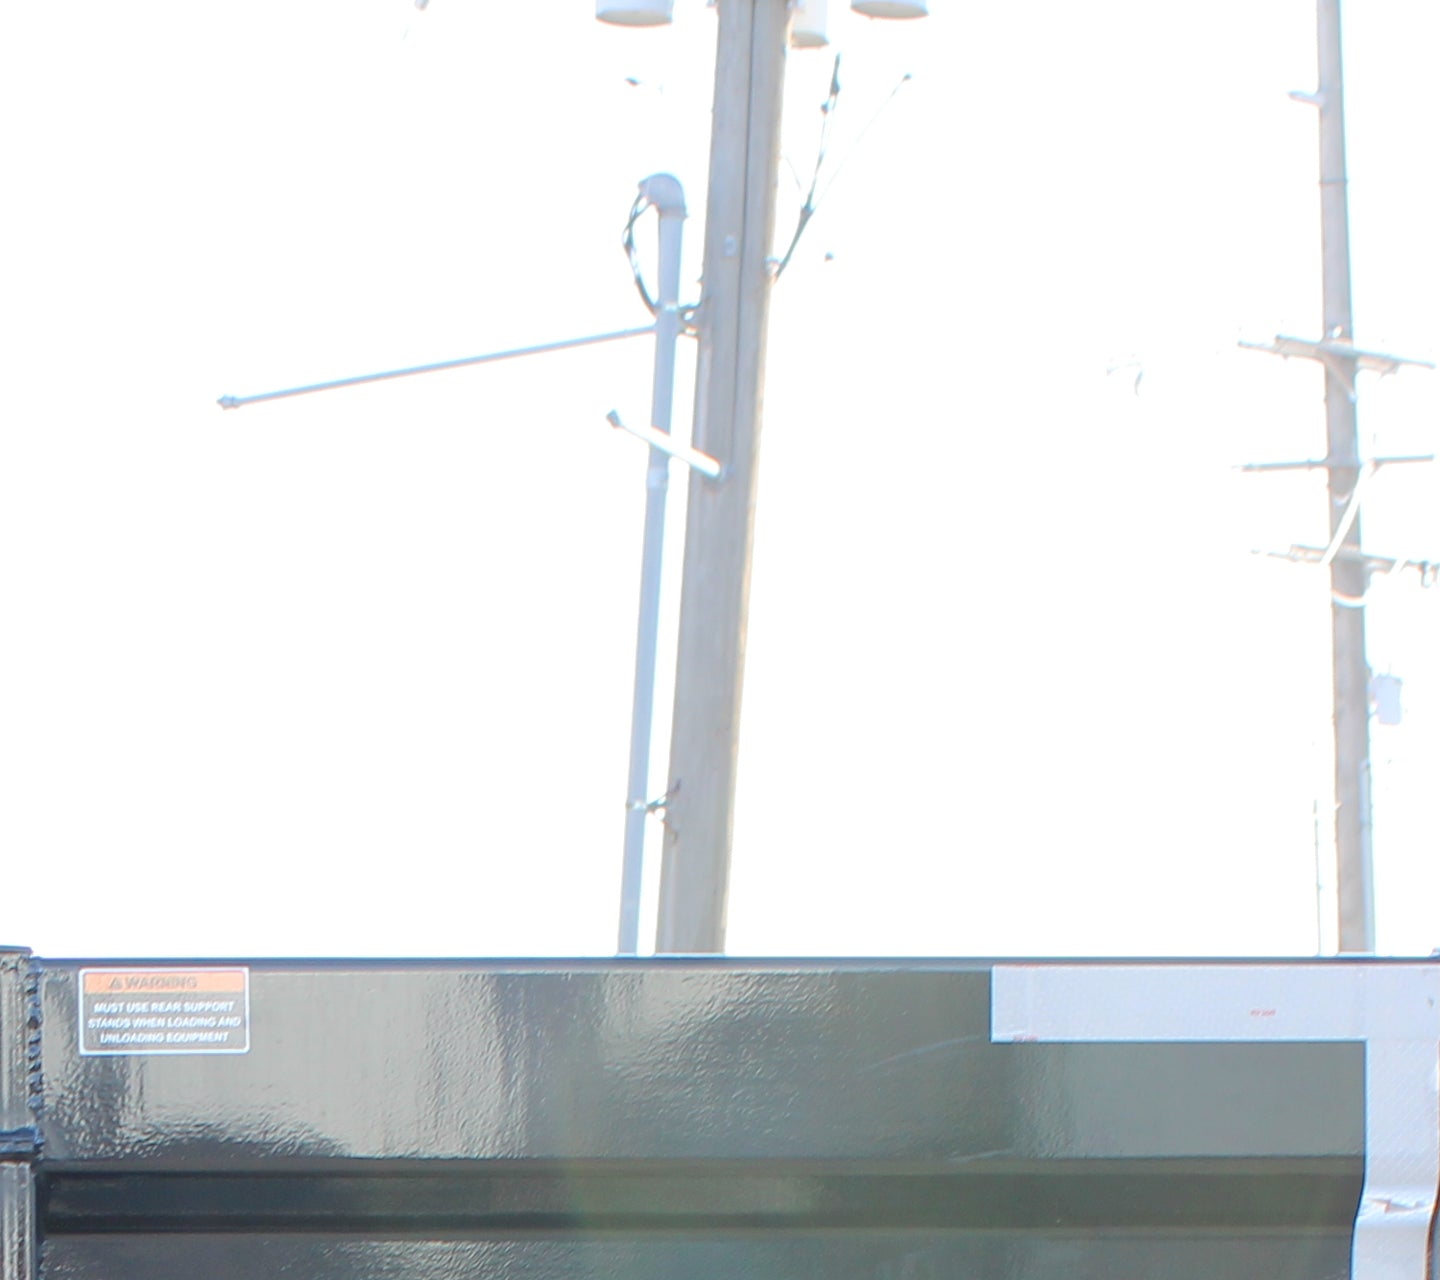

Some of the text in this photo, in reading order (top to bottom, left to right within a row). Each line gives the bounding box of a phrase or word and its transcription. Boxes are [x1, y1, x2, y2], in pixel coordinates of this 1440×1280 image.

[94, 1001, 234, 1013] MUST USE REAR SUPPORT
[88, 1016, 241, 1029] STANDS WHEN LOADING AND
